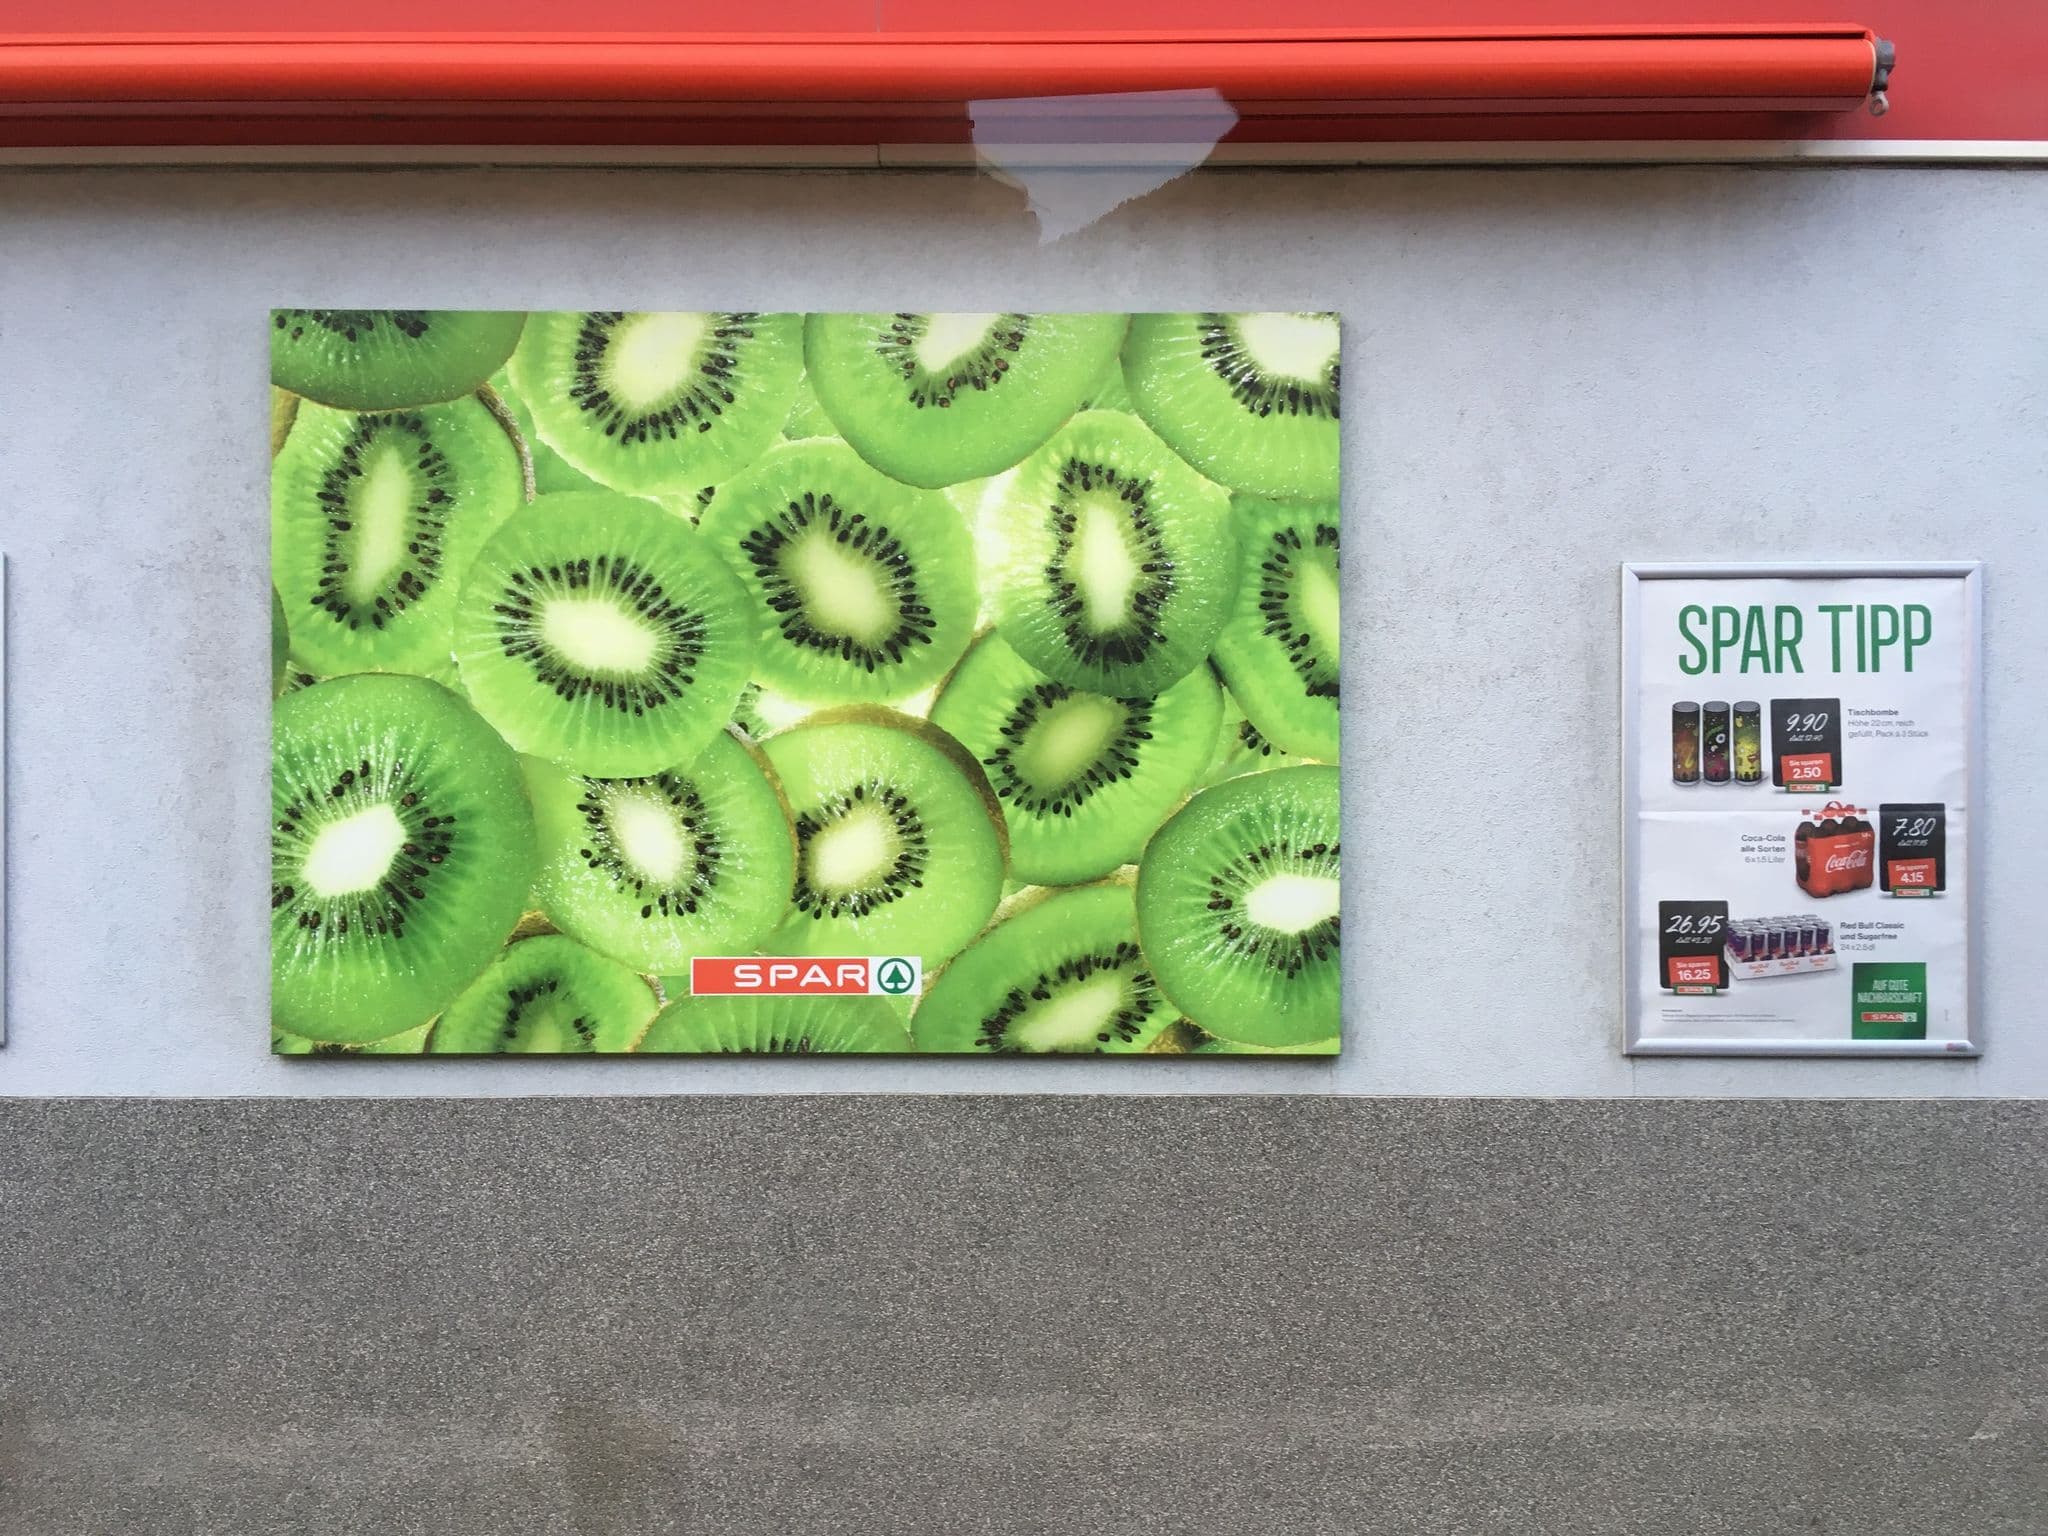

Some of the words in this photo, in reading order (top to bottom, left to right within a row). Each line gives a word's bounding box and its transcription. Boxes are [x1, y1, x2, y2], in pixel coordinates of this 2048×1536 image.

[1678, 604, 1804, 676] SPAR
[1818, 604, 1932, 673] TIPP
[1847, 708, 1900, 717] Tischbombe
[1785, 712, 1829, 732] 9.90
[1792, 766, 1822, 779] 2.50
[1892, 817, 1937, 837] 7.80
[1741, 833, 1786, 842] Coca-Cola
[1740, 844, 1756, 853] alle
[1757, 844, 1786, 853] Sorten
[1900, 871, 1925, 883] 4.15
[1664, 914, 1726, 934] 26.95
[1840, 921, 1857, 930] Red
[1857, 921, 1874, 930] Bull
[1875, 921, 1905, 930] Classic
[1840, 932, 1856, 940] und
[1857, 932, 1898, 942] Sugarfree
[733, 964, 866, 987] SPAR
[1677, 968, 1712, 981] 16.25
[1871, 1012, 1905, 1021] SPAR
